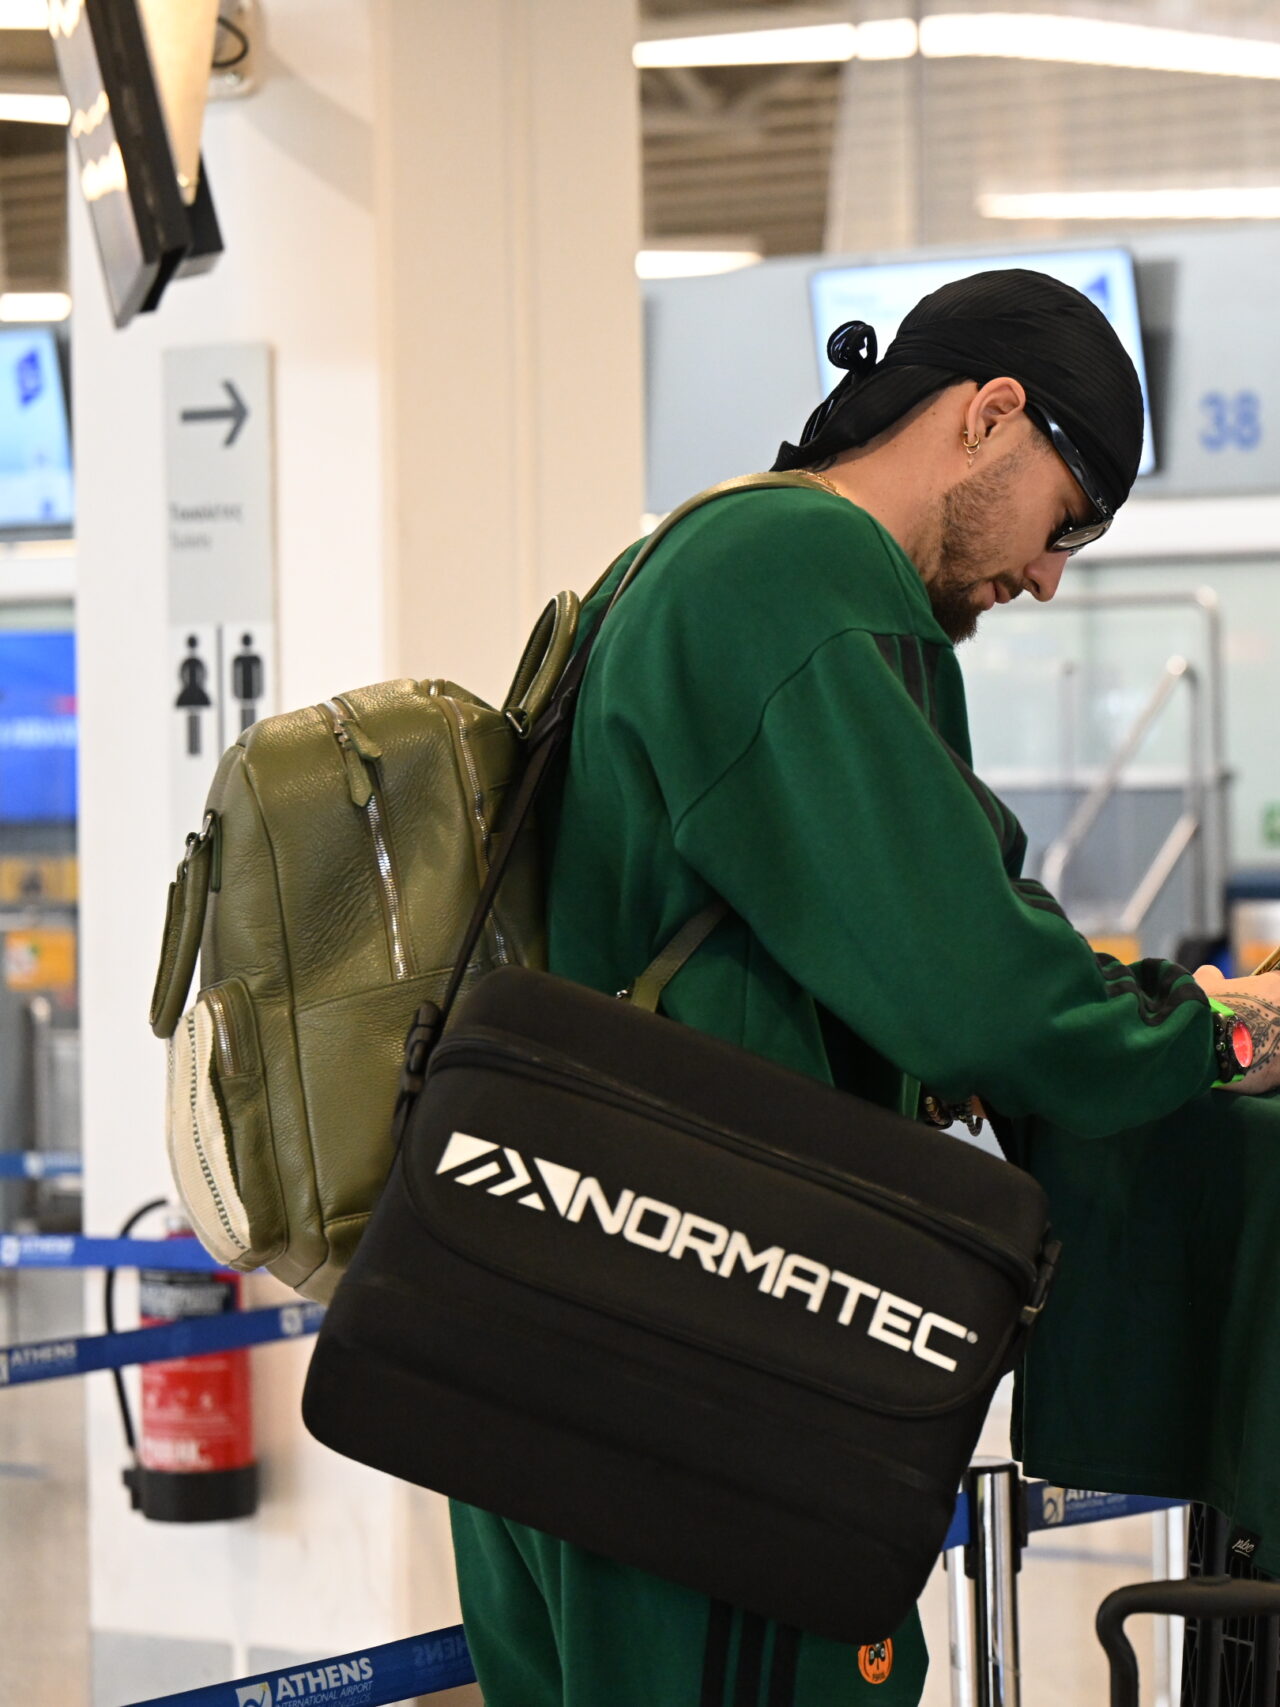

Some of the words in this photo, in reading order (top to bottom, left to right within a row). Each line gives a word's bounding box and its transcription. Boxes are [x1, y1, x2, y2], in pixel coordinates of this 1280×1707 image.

[1199, 390, 1263, 452] 38
[566, 1176, 968, 1372] NORMATEC
[276, 1657, 373, 1702] ATHENS
[340, 1680, 374, 1698] AIRPORT
